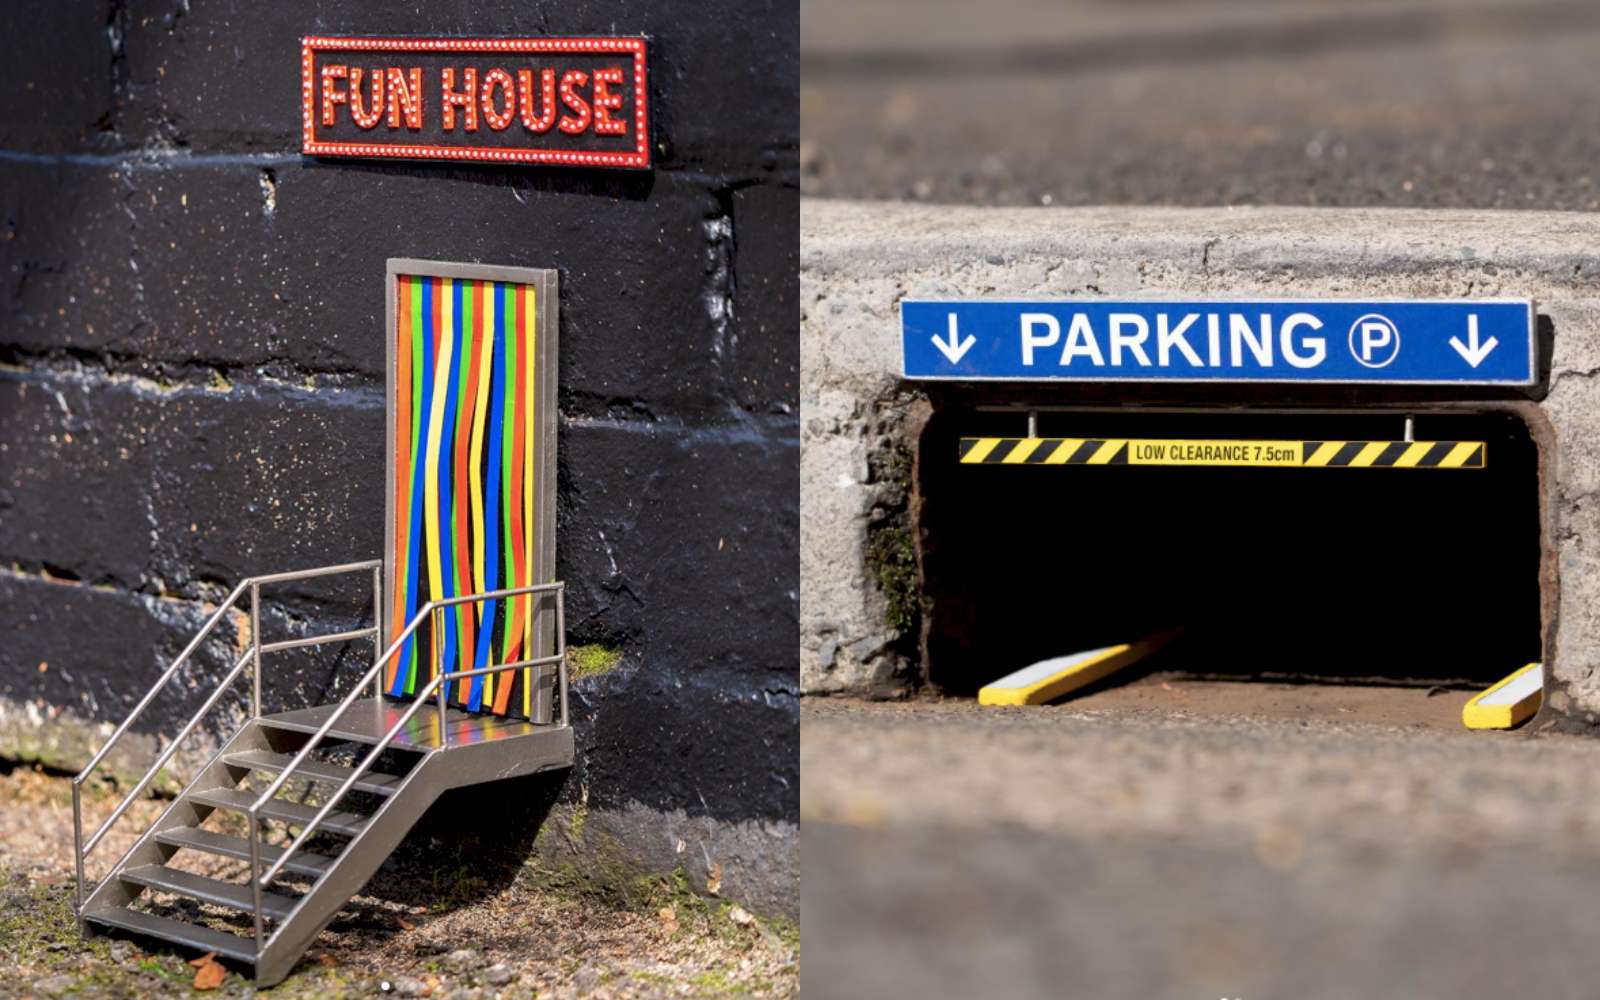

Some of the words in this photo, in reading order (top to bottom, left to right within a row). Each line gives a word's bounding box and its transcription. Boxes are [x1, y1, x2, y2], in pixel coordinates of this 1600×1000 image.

[321, 64, 422, 130] FUN
[441, 66, 627, 136] HOUSE
[1019, 312, 1327, 368] PARKING
[1136, 444, 1166, 460] LOW
[1170, 445, 1249, 461] CLEARANCE
[1254, 445, 1295, 462] 7.5cm
